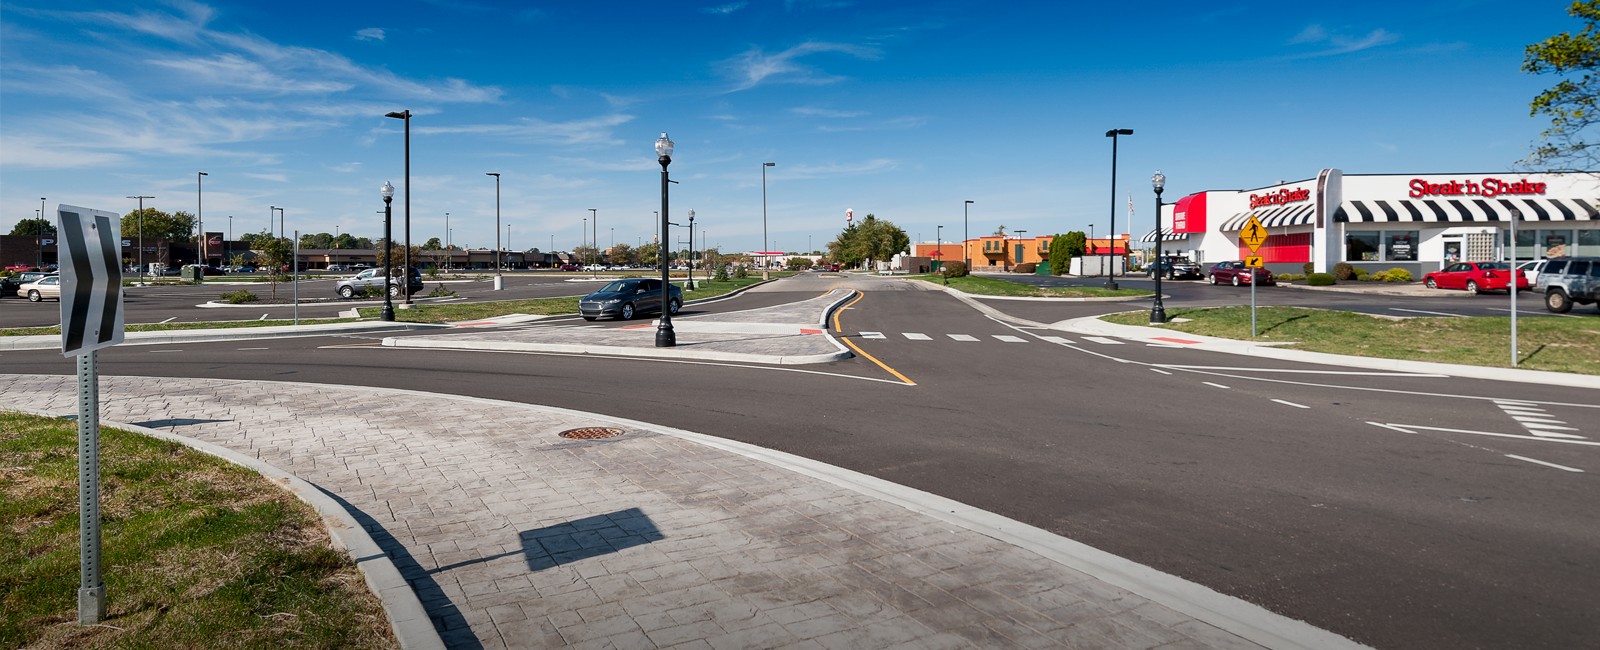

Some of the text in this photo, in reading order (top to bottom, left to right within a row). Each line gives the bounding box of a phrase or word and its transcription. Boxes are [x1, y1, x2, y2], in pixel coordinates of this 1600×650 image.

[1409, 179, 1464, 197] Steak
[1482, 178, 1547, 197] Shake
[1249, 193, 1271, 209] Steak
[1279, 187, 1309, 205] Shake
[1175, 211, 1186, 221] DRIVE
[1175, 221, 1186, 230] THRU
